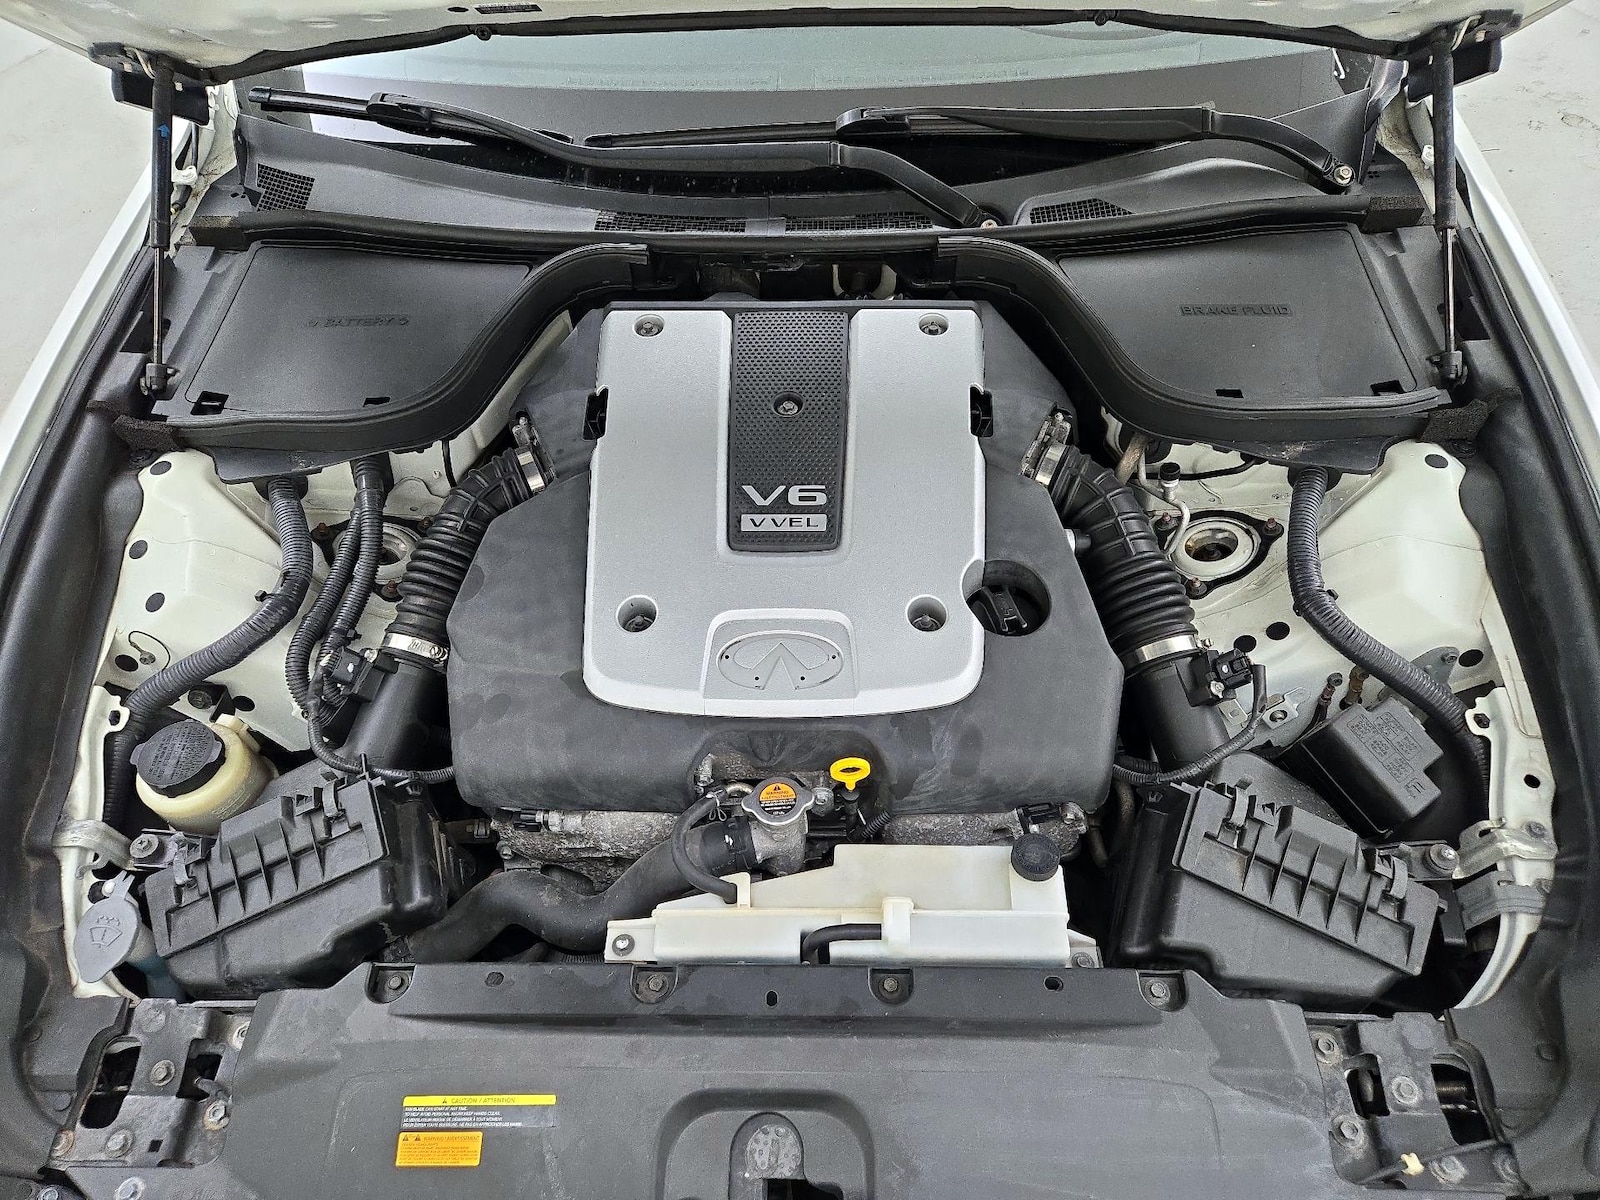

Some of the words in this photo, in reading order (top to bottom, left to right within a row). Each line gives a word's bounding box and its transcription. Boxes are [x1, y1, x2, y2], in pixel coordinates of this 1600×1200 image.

[1180, 305, 1238, 316] BRAKE
[1242, 304, 1291, 315] FLUID
[323, 316, 395, 327] BATTERY
[741, 485, 828, 506] V6
[749, 517, 819, 528] VVEL
